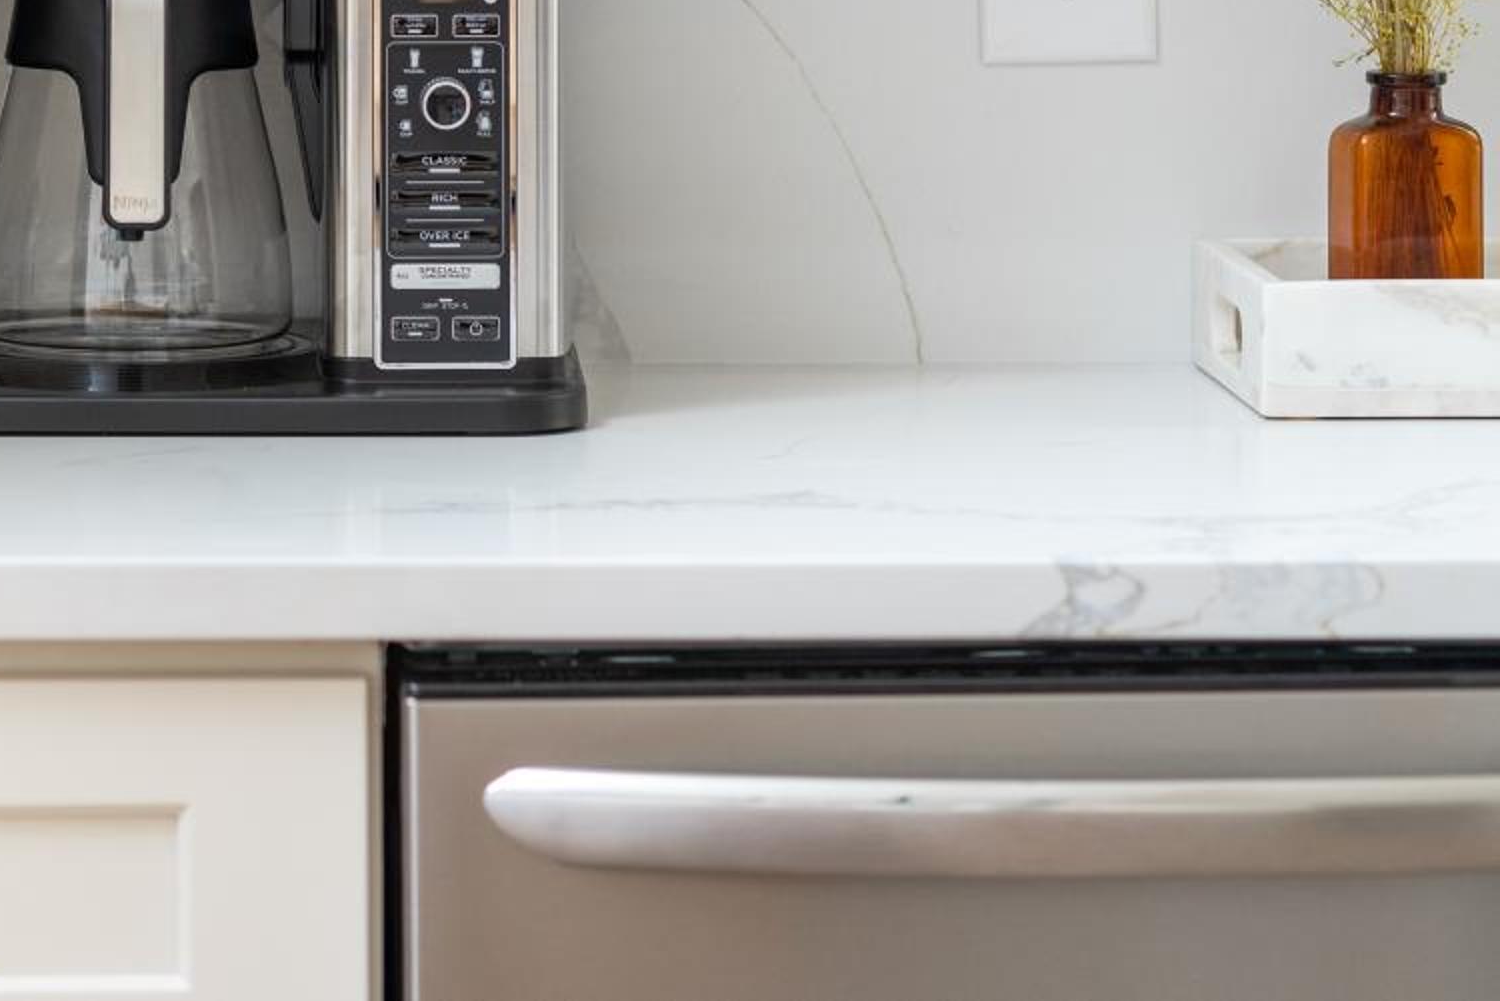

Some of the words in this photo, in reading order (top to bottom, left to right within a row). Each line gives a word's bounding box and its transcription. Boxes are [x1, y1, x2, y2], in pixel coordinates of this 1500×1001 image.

[421, 156, 468, 166] CLASSIC
[430, 194, 458, 203] RICH
[419, 231, 449, 240] OVER
[452, 231, 471, 240] ICE
